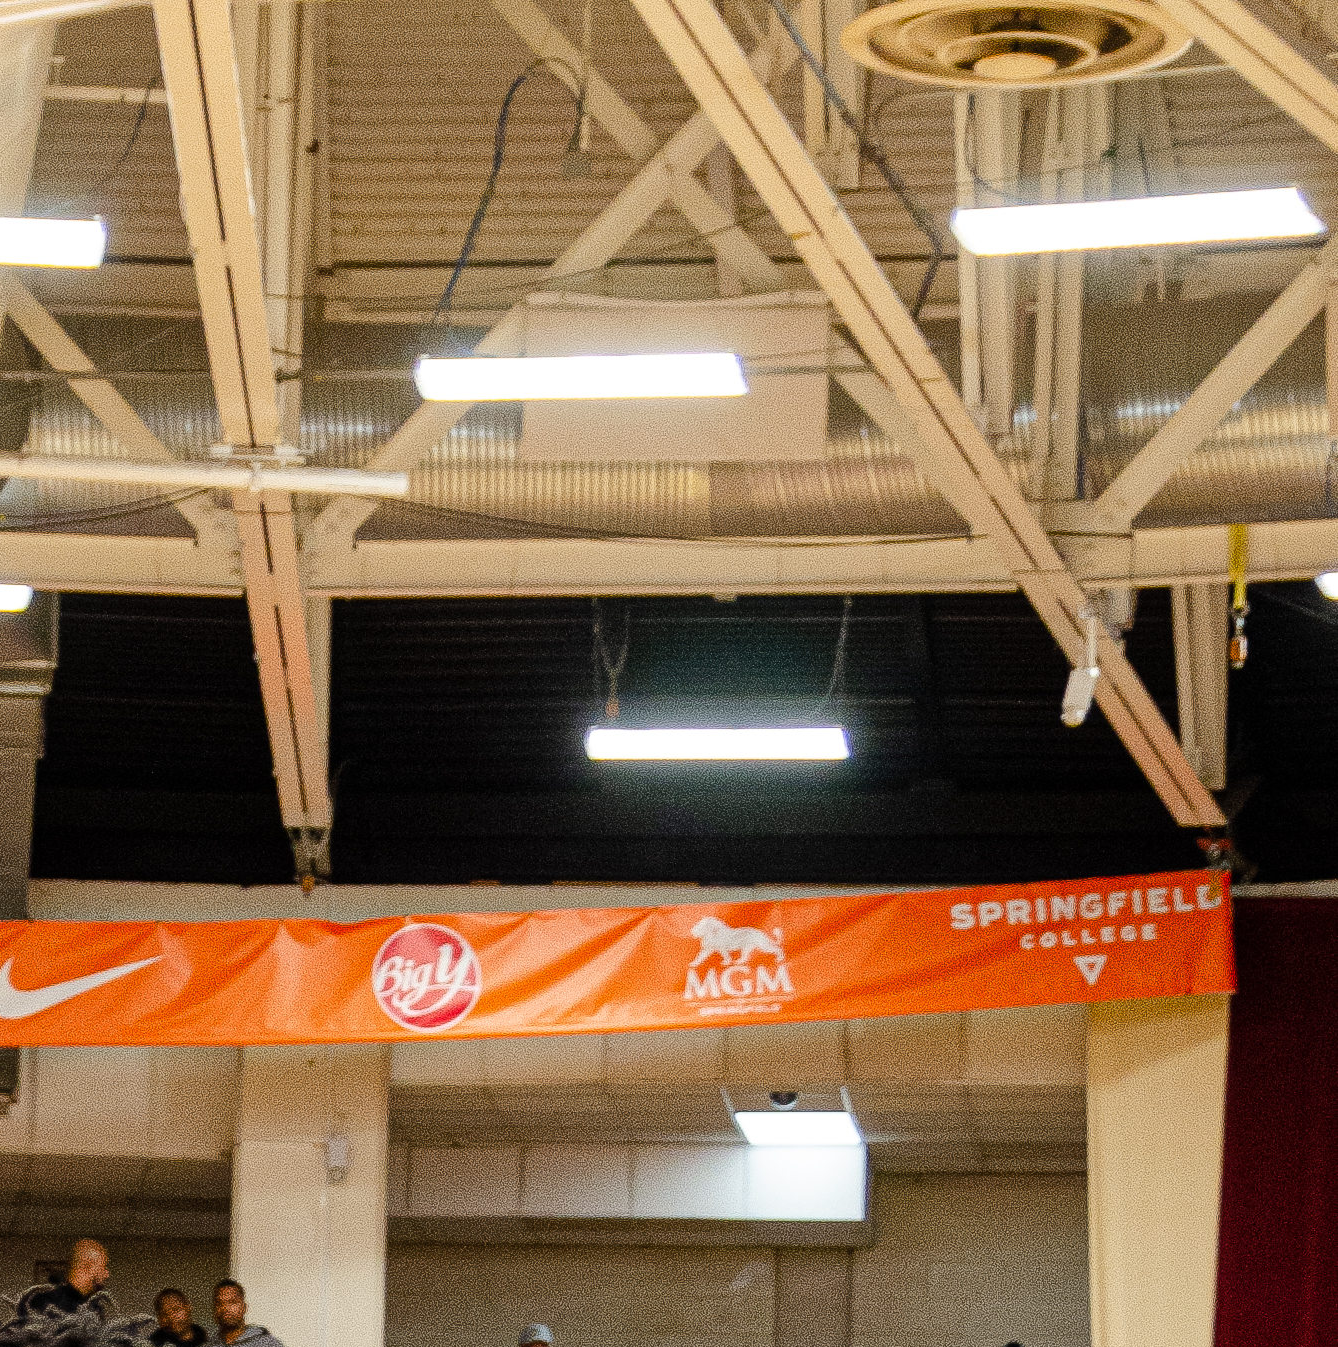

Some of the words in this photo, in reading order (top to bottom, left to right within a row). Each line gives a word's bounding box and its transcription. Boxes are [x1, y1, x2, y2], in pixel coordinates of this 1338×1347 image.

[1020, 924, 1158, 950] COLLEGE
[374, 955, 433, 1010] Big
[683, 964, 795, 999] MGM
